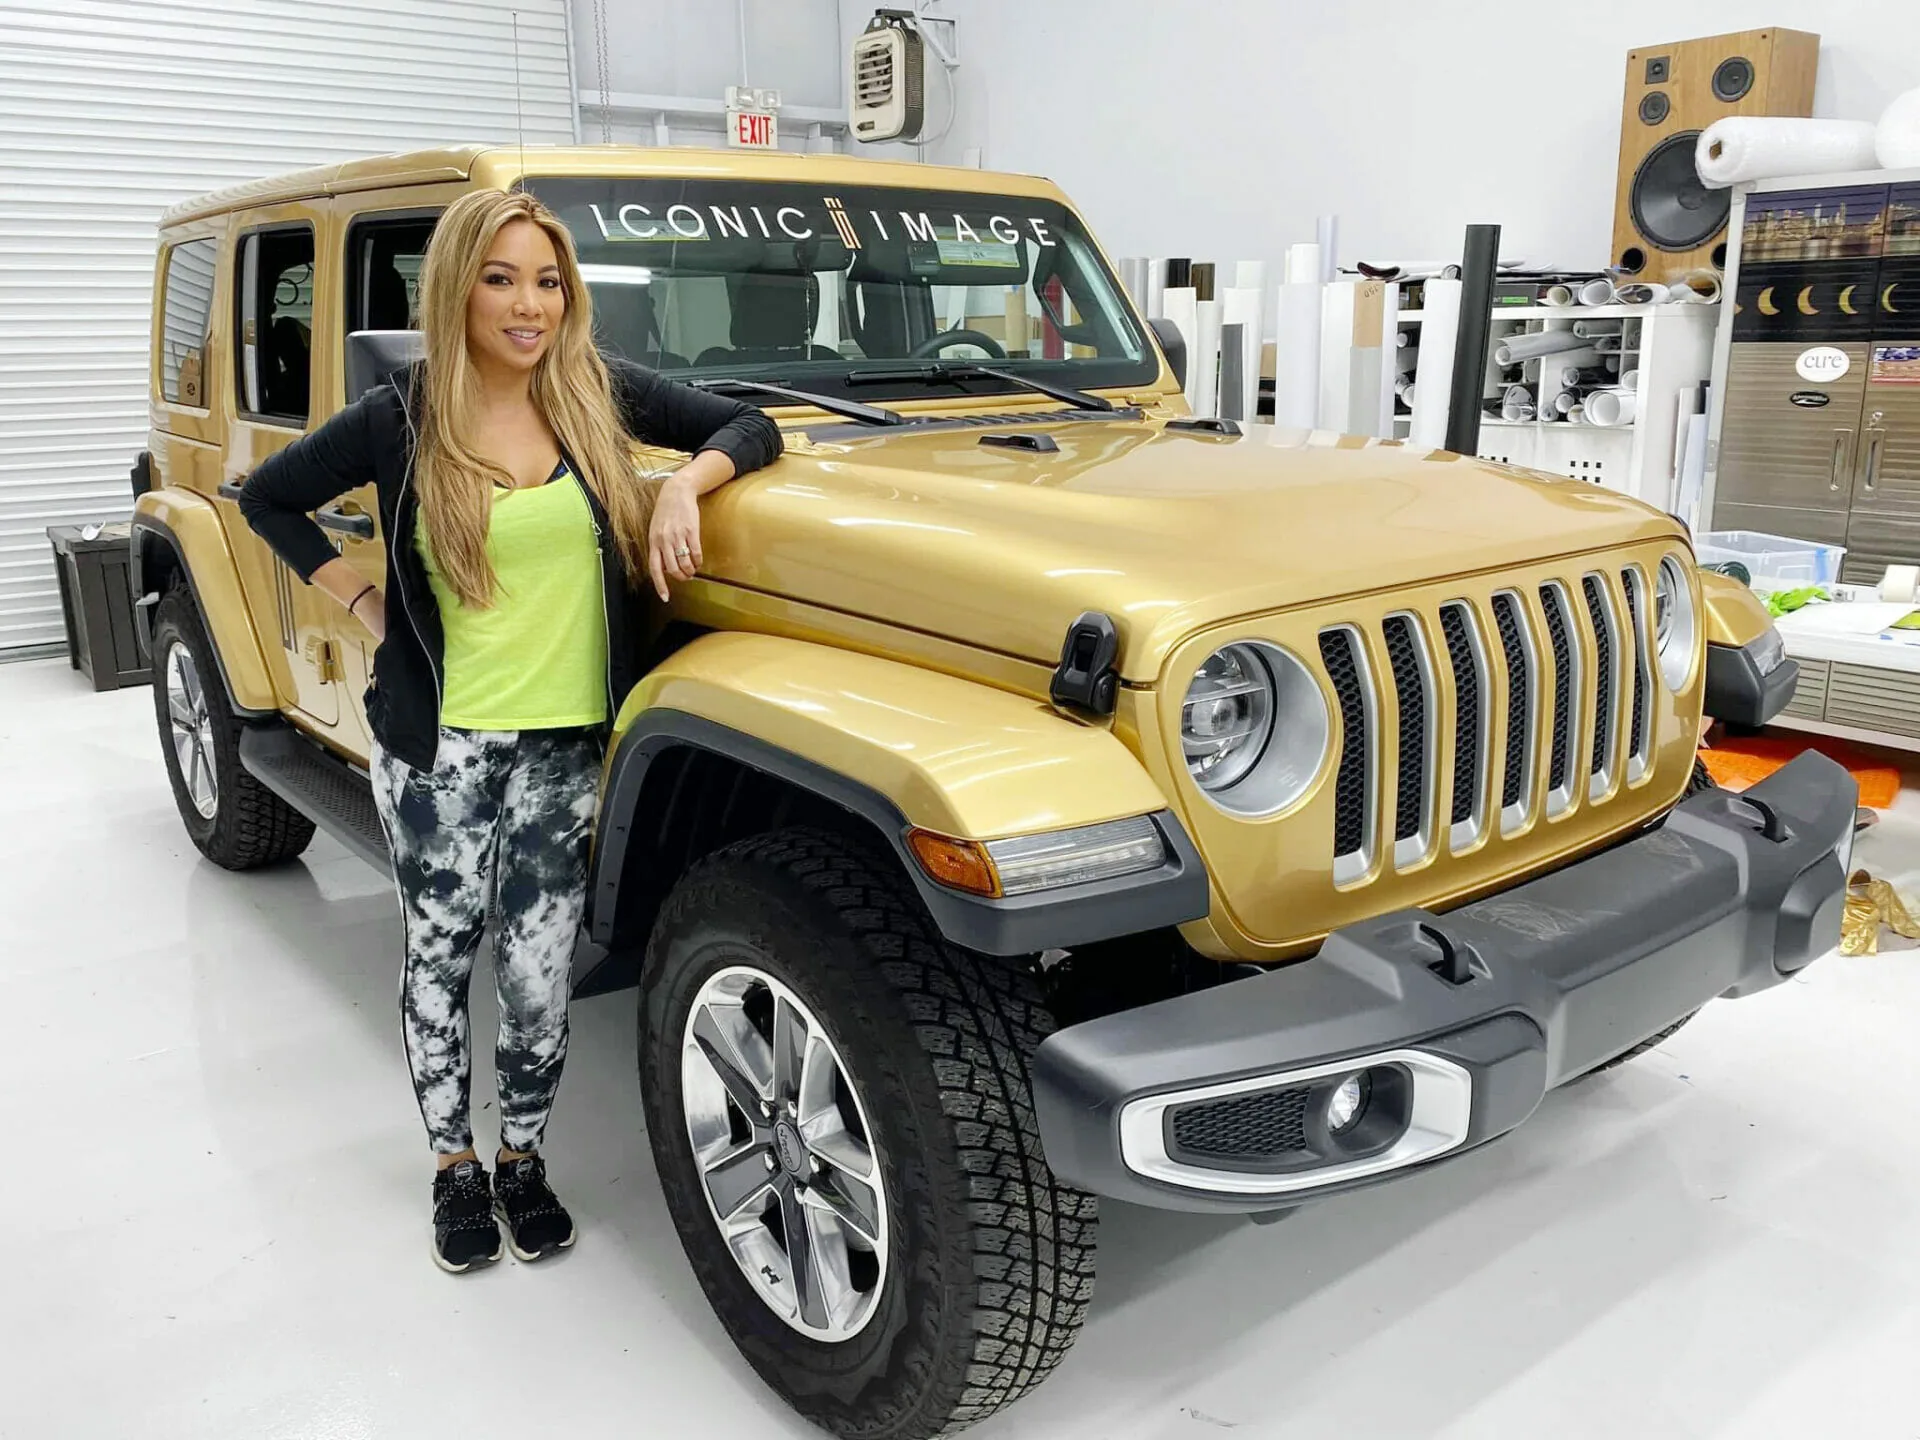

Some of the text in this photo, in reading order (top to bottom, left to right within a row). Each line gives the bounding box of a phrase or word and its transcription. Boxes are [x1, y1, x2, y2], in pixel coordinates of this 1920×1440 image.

[739, 114, 771, 145] EXIT
[588, 204, 813, 239] ICONIC
[869, 210, 1056, 247] IMAGE
